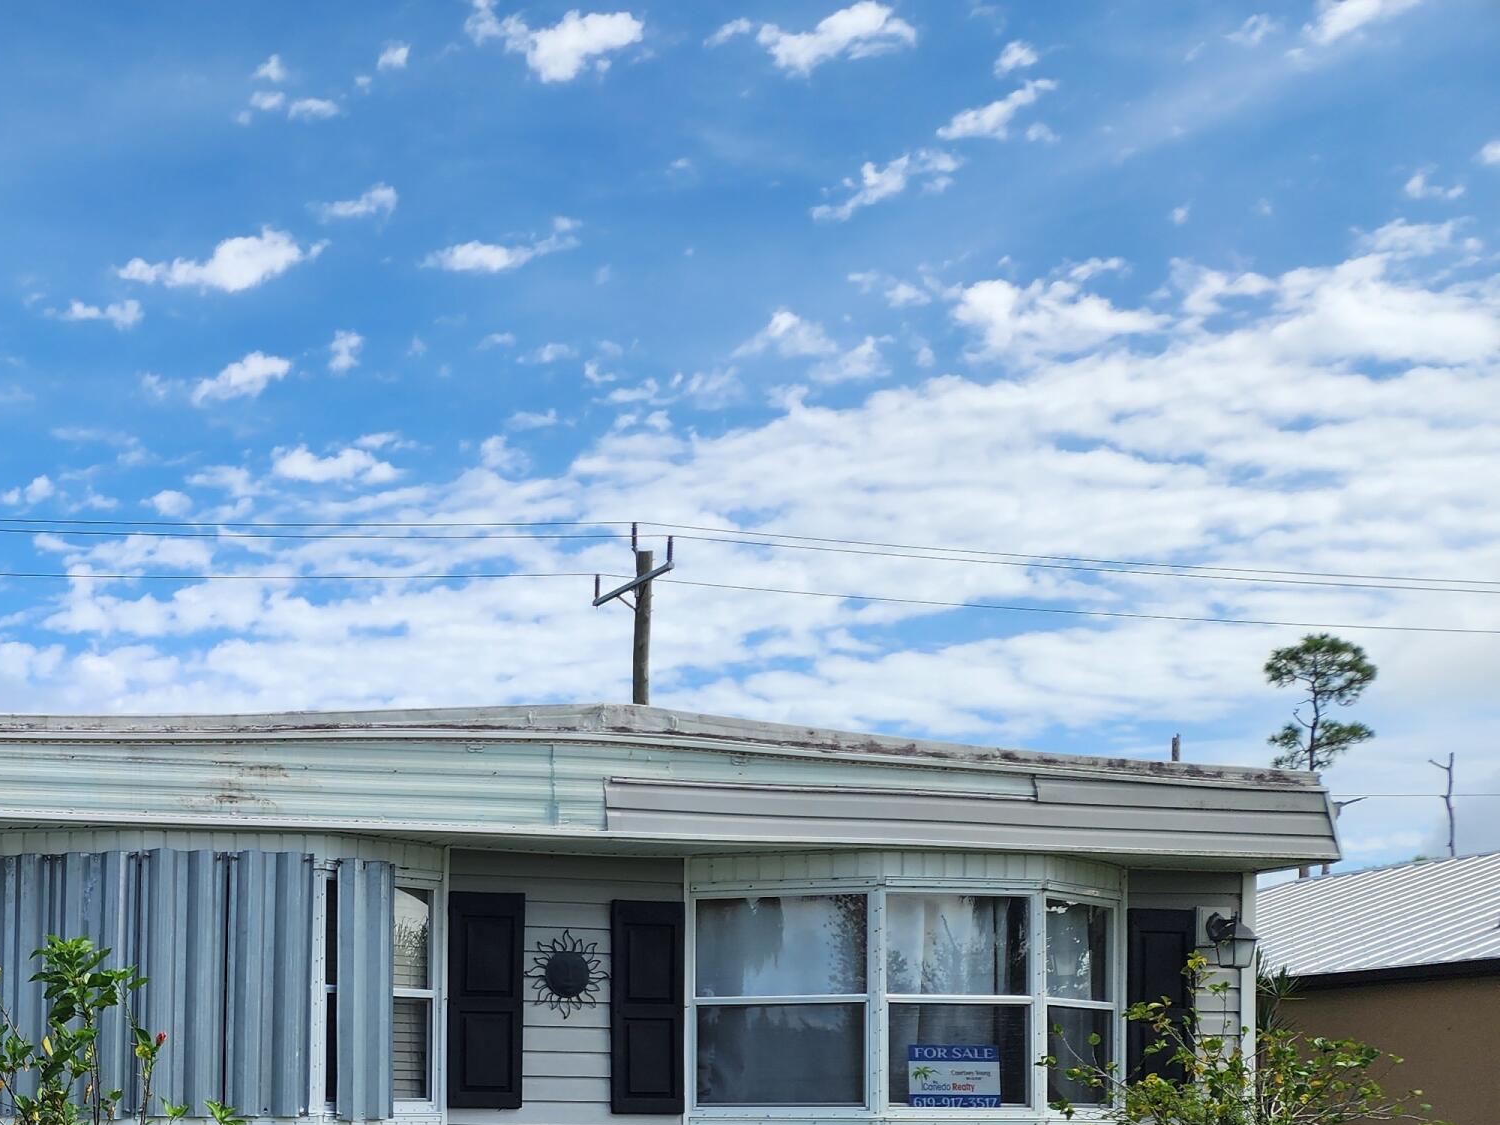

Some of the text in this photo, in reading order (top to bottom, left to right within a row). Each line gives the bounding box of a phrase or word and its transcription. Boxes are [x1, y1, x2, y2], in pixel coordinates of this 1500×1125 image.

[914, 1047, 996, 1059] FOR SALE
[952, 1082, 975, 1092] Realty
[913, 1097, 998, 1107] 619-917-3517
